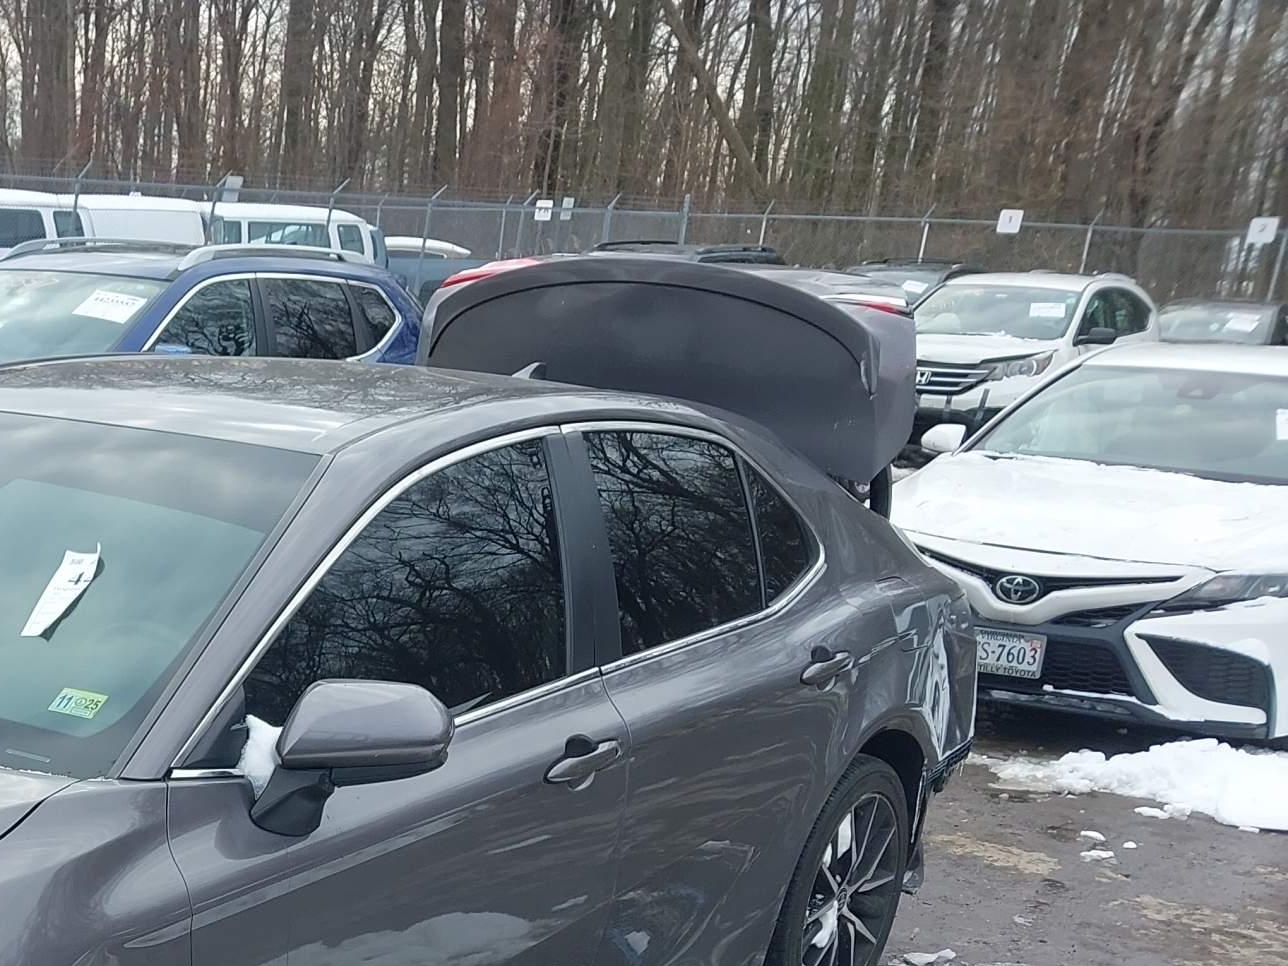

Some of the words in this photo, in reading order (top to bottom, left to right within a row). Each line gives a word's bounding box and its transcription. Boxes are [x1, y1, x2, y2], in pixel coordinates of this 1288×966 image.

[977, 641, 1038, 666] S-7603
[978, 663, 1002, 674] TILLY
[1003, 667, 1036, 678] TOYOTA
[55, 694, 74, 709] 11
[83, 698, 102, 711] 25
